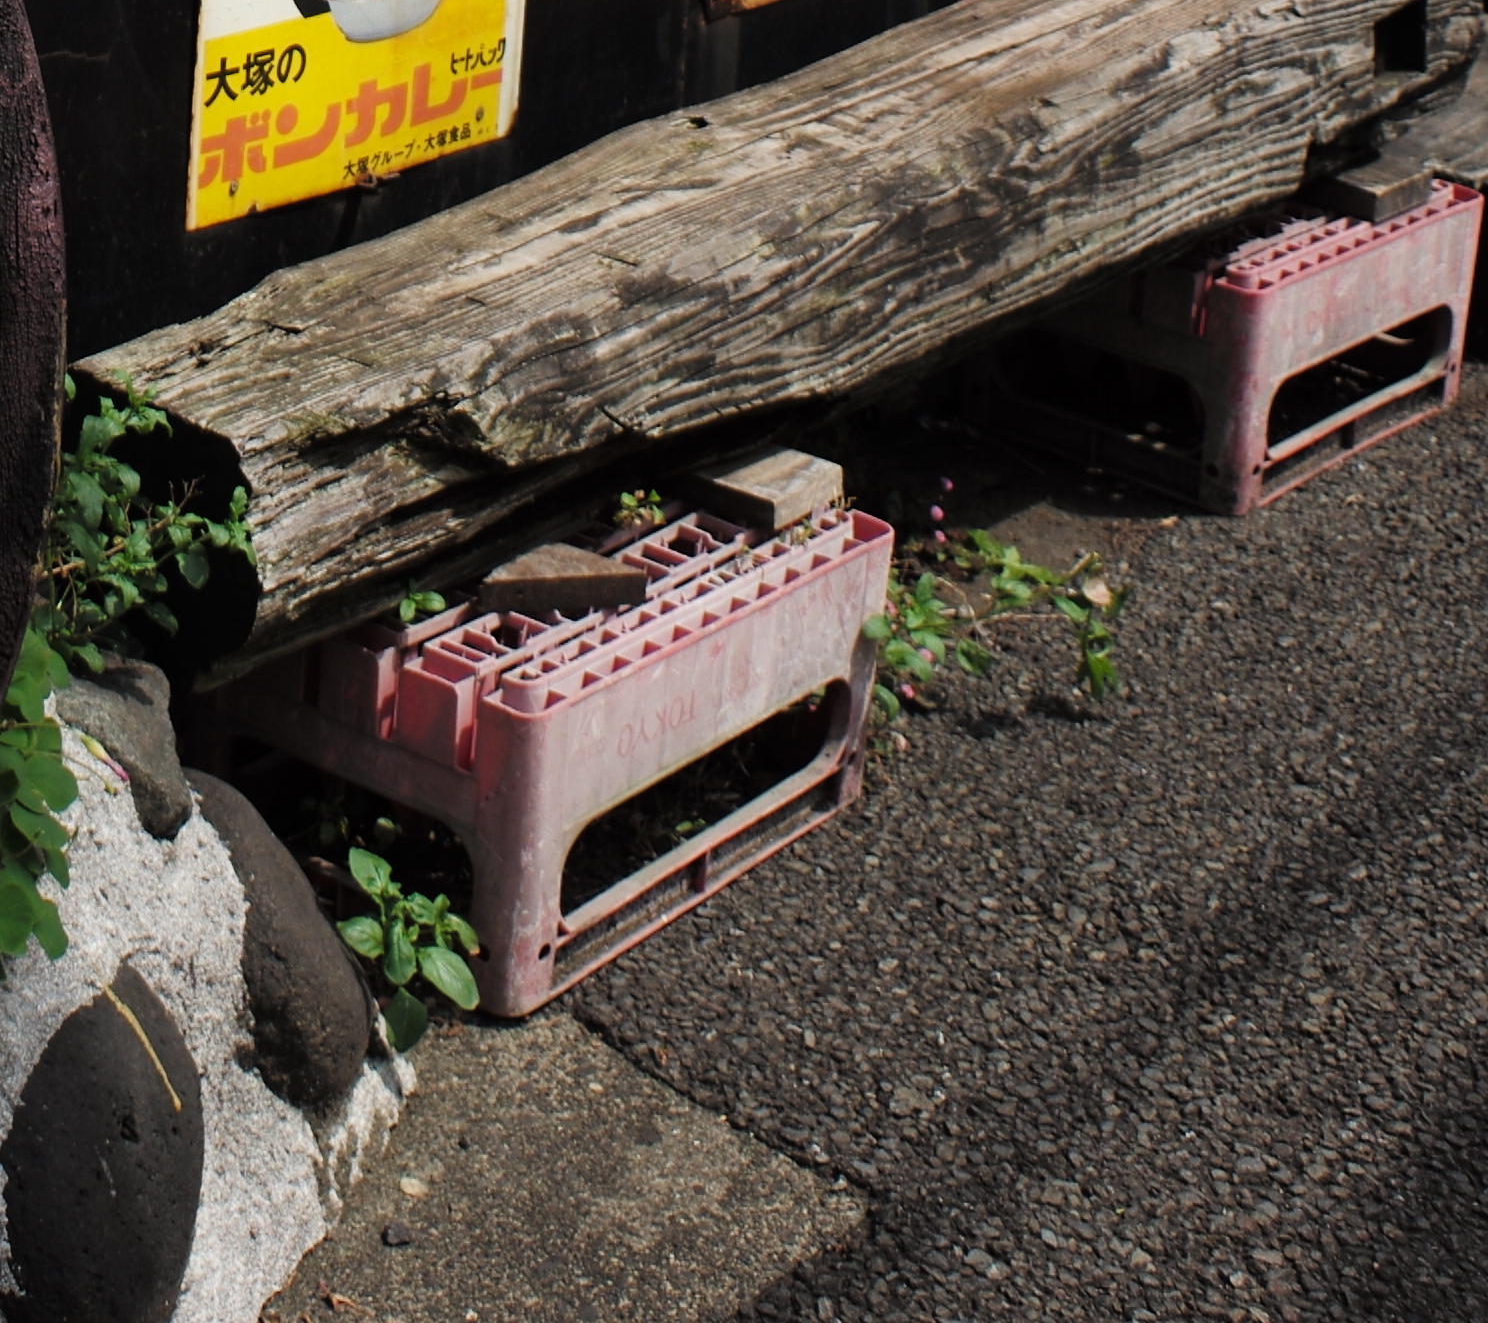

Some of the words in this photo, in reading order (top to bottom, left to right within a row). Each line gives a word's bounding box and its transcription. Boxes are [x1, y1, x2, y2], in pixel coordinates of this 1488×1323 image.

[203, 43, 308, 108] 大塚の
[198, 63, 503, 190] ボンカレー
